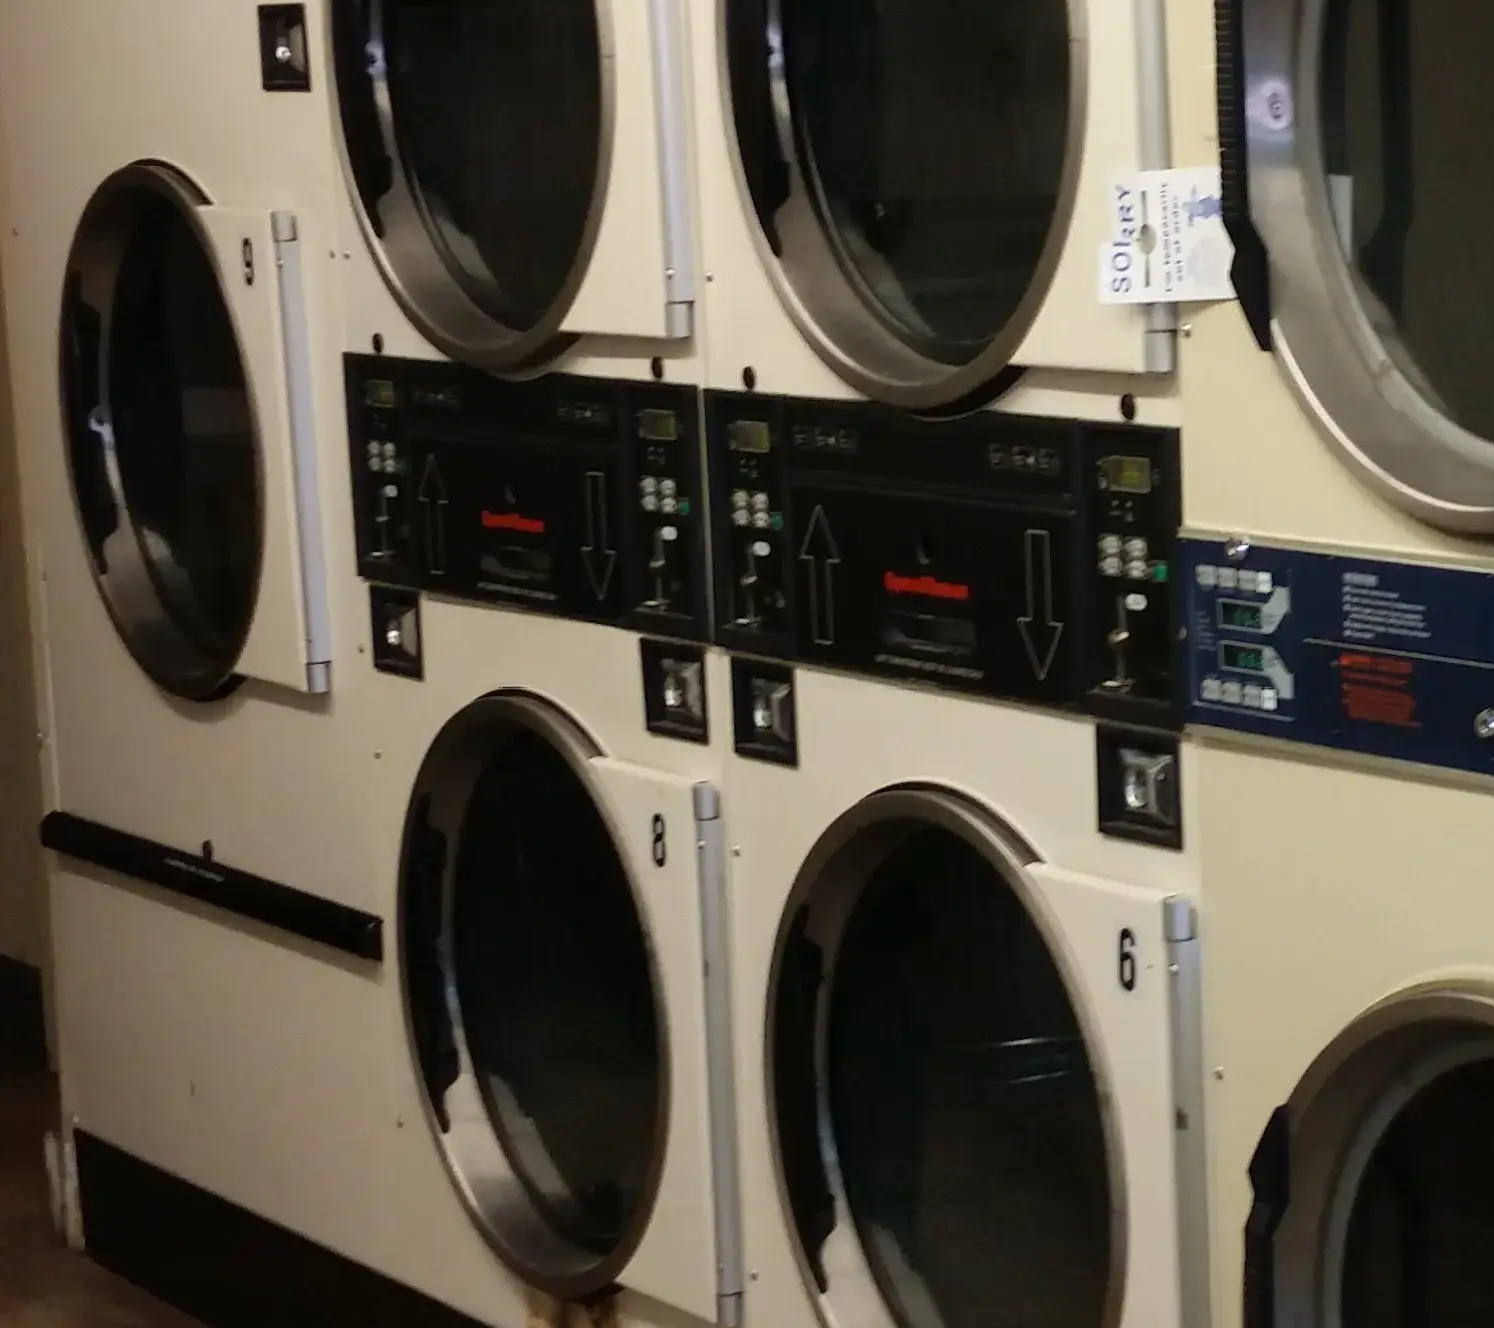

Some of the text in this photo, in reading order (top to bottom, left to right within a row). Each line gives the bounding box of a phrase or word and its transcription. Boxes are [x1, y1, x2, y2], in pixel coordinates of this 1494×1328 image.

[242, 237, 255, 286] 9
[652, 813, 667, 869] 8
[1119, 927, 1137, 992] 6
